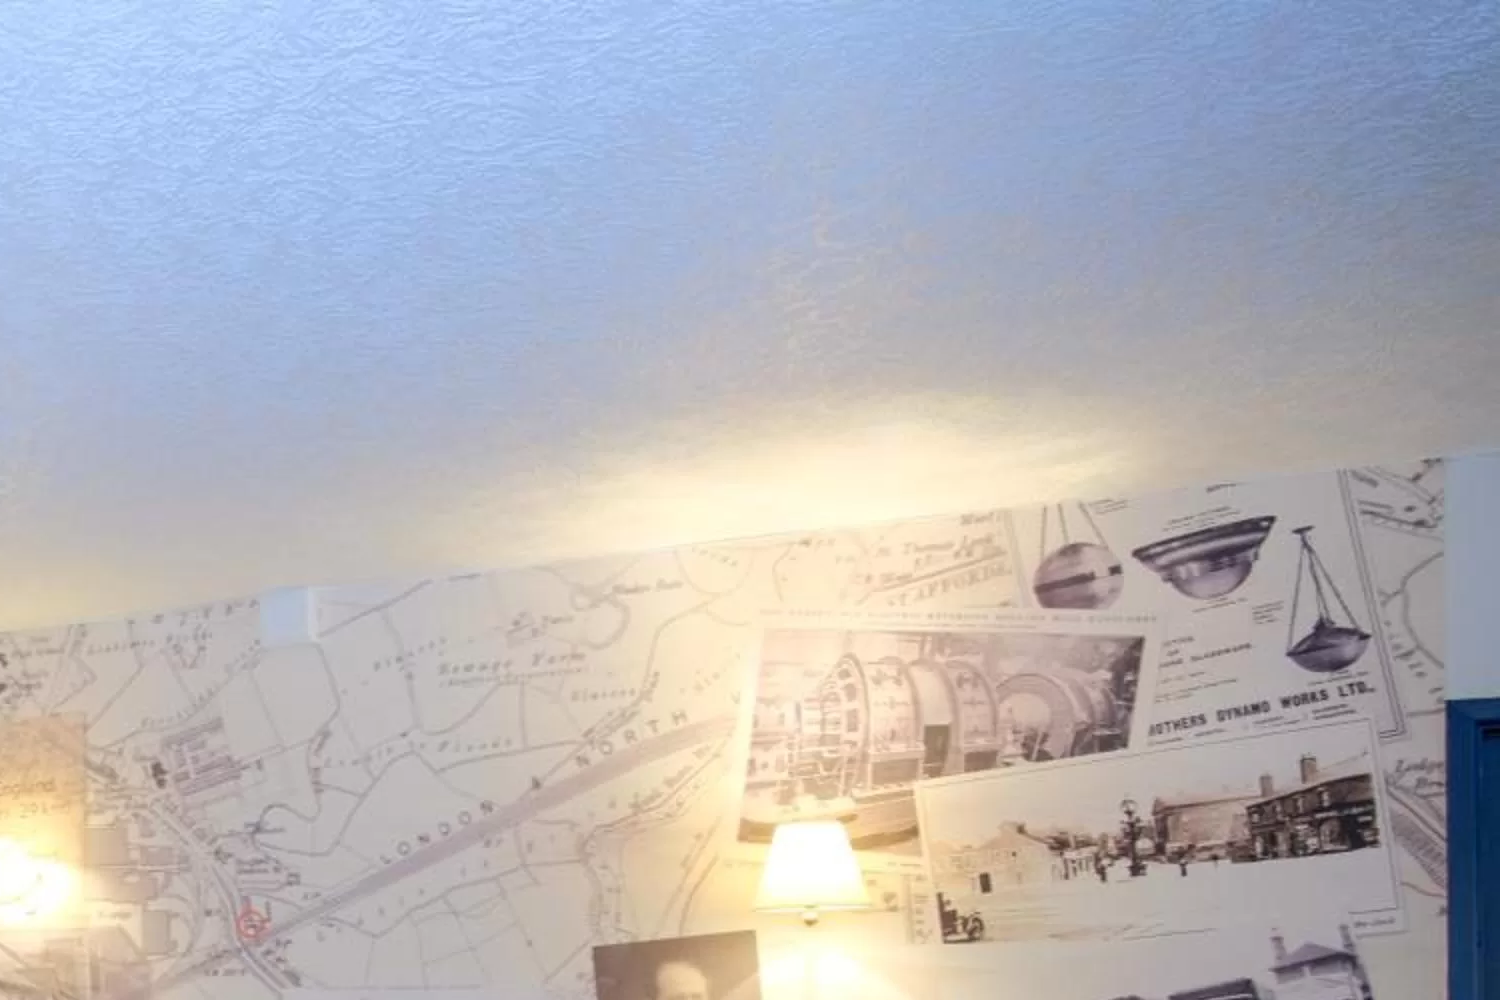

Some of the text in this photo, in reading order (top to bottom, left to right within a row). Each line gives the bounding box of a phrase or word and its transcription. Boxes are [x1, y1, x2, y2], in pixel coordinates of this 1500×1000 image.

[1216, 700, 1271, 723] DYNAMO
[1280, 688, 1330, 708] WORKS
[380, 798, 494, 867] LONDON
